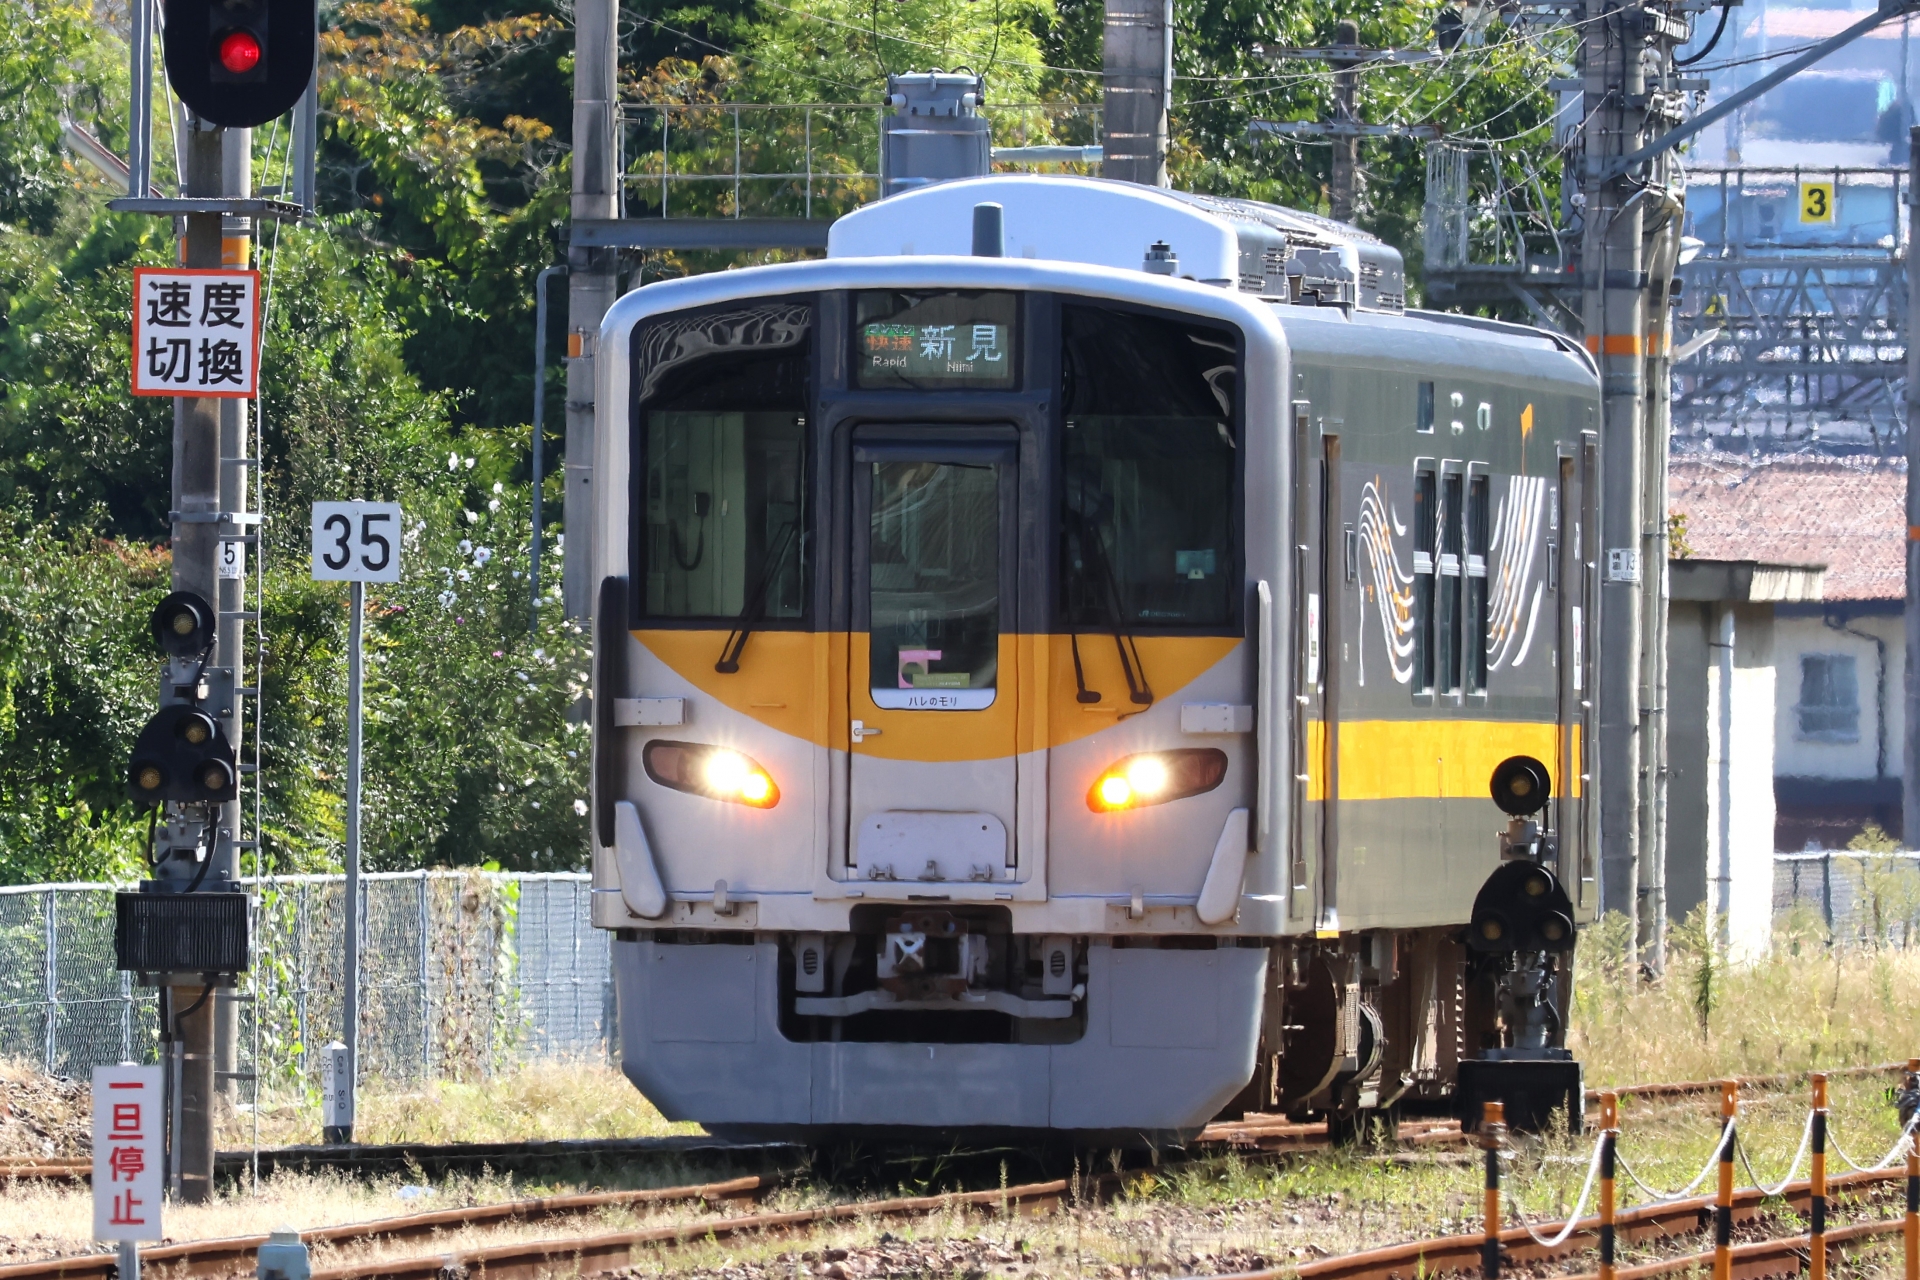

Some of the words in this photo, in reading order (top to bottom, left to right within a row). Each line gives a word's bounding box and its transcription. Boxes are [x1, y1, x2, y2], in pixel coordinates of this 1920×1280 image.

[1807, 188, 1827, 217] 3
[147, 281, 246, 329] 速度
[867, 335, 912, 351] 快速
[919, 325, 1002, 361] 新見
[146, 337, 244, 385] 切換
[872, 355, 907, 369] Rapid
[946, 361, 974, 373] Niimi
[224, 542, 235, 565] 5
[323, 514, 391, 571] 35
[908, 696, 957, 707] ハレのモリ
[108, 1082, 145, 1225] 一旦停止
